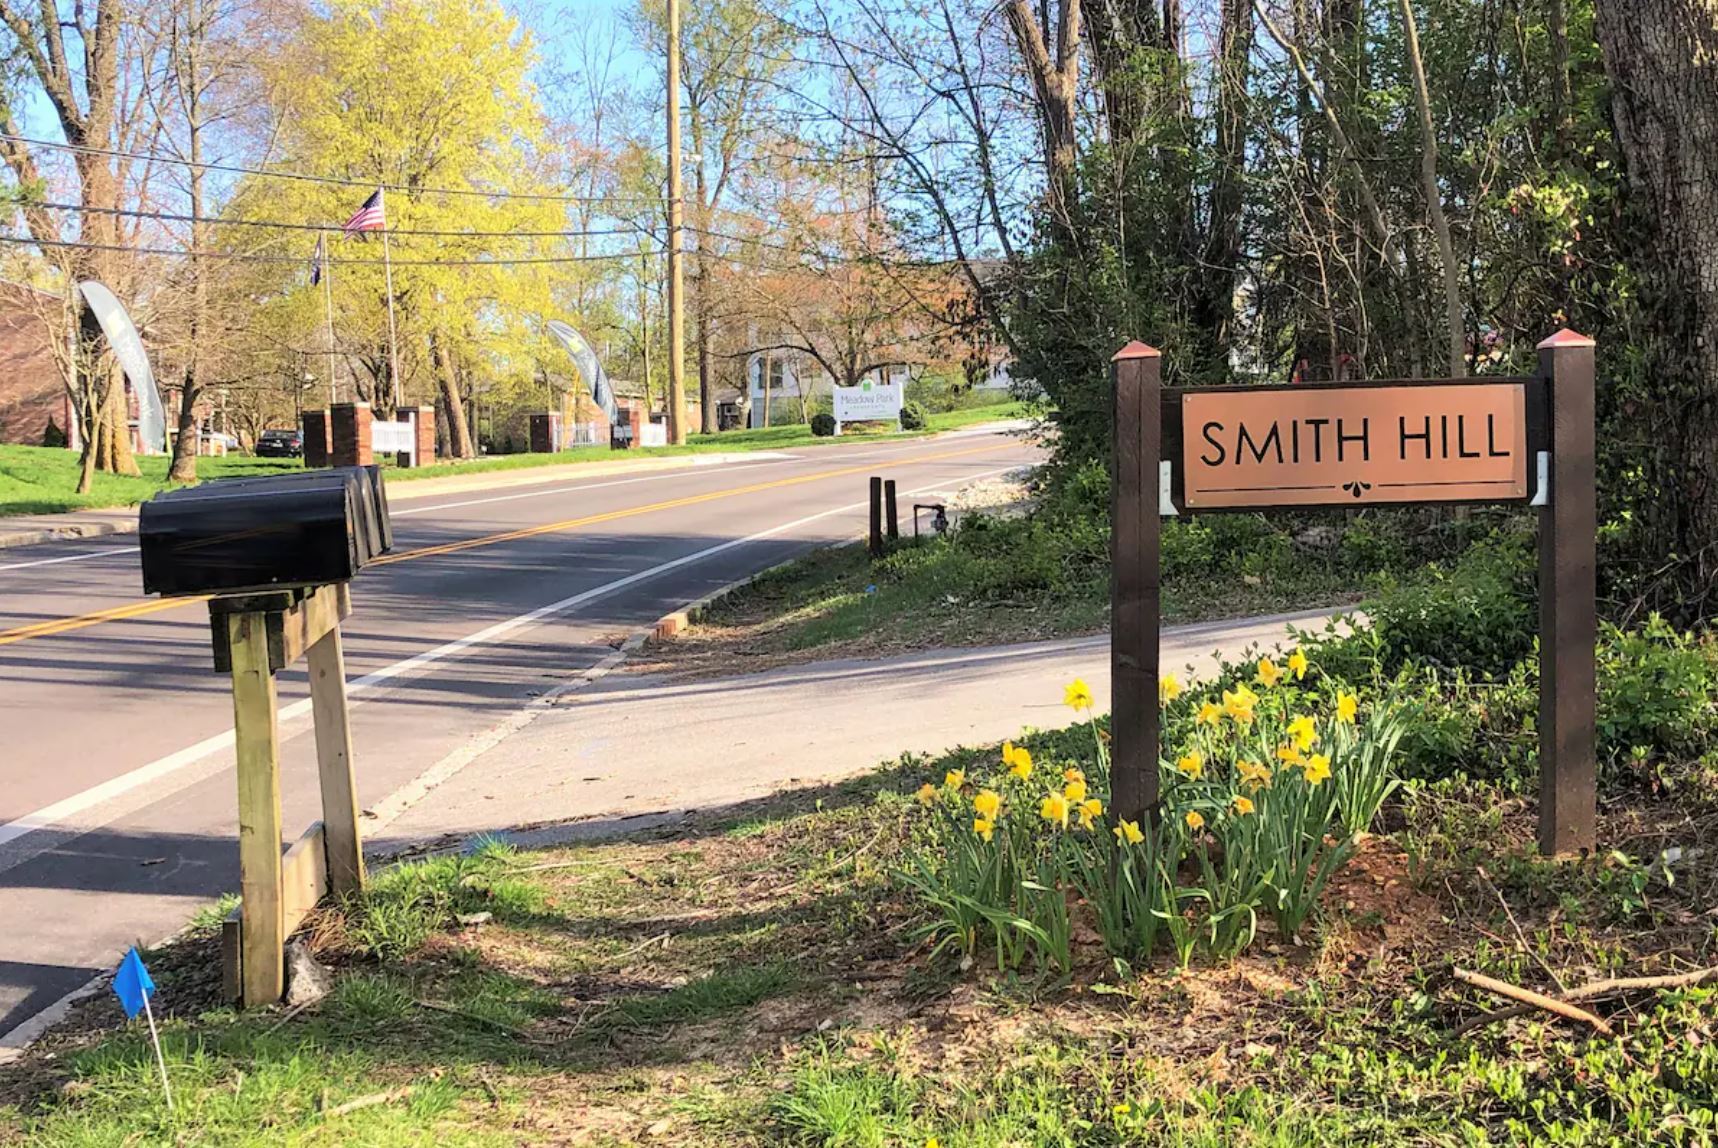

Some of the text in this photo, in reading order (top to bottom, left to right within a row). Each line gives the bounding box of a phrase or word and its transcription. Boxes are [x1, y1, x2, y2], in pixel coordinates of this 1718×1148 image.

[840, 392, 895, 405] Meadow Park
[1200, 413, 1511, 467] SMITH HILL
